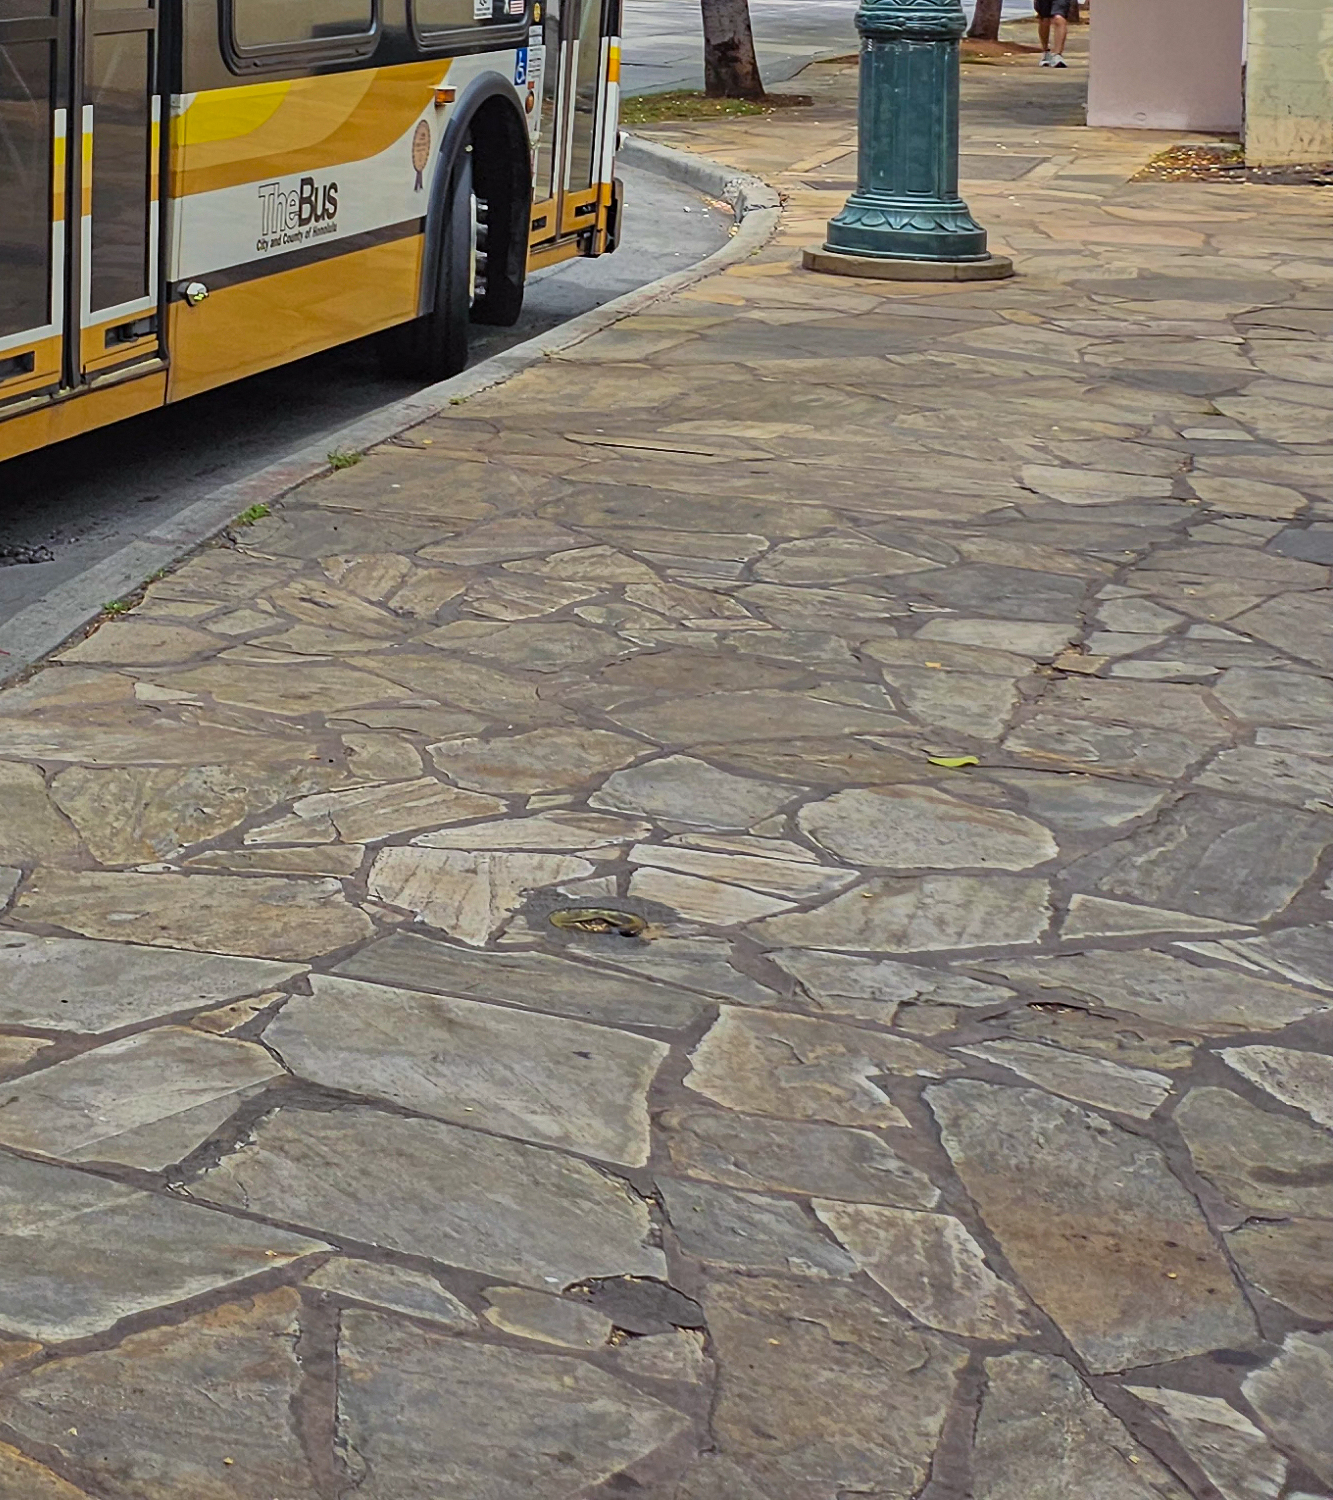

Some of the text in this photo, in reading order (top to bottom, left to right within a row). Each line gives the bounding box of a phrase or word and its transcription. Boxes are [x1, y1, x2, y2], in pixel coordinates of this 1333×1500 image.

[258, 176, 338, 236] TheBus
[256, 238, 268, 252] City
[270, 234, 282, 247] and
[283, 230, 303, 244] County
